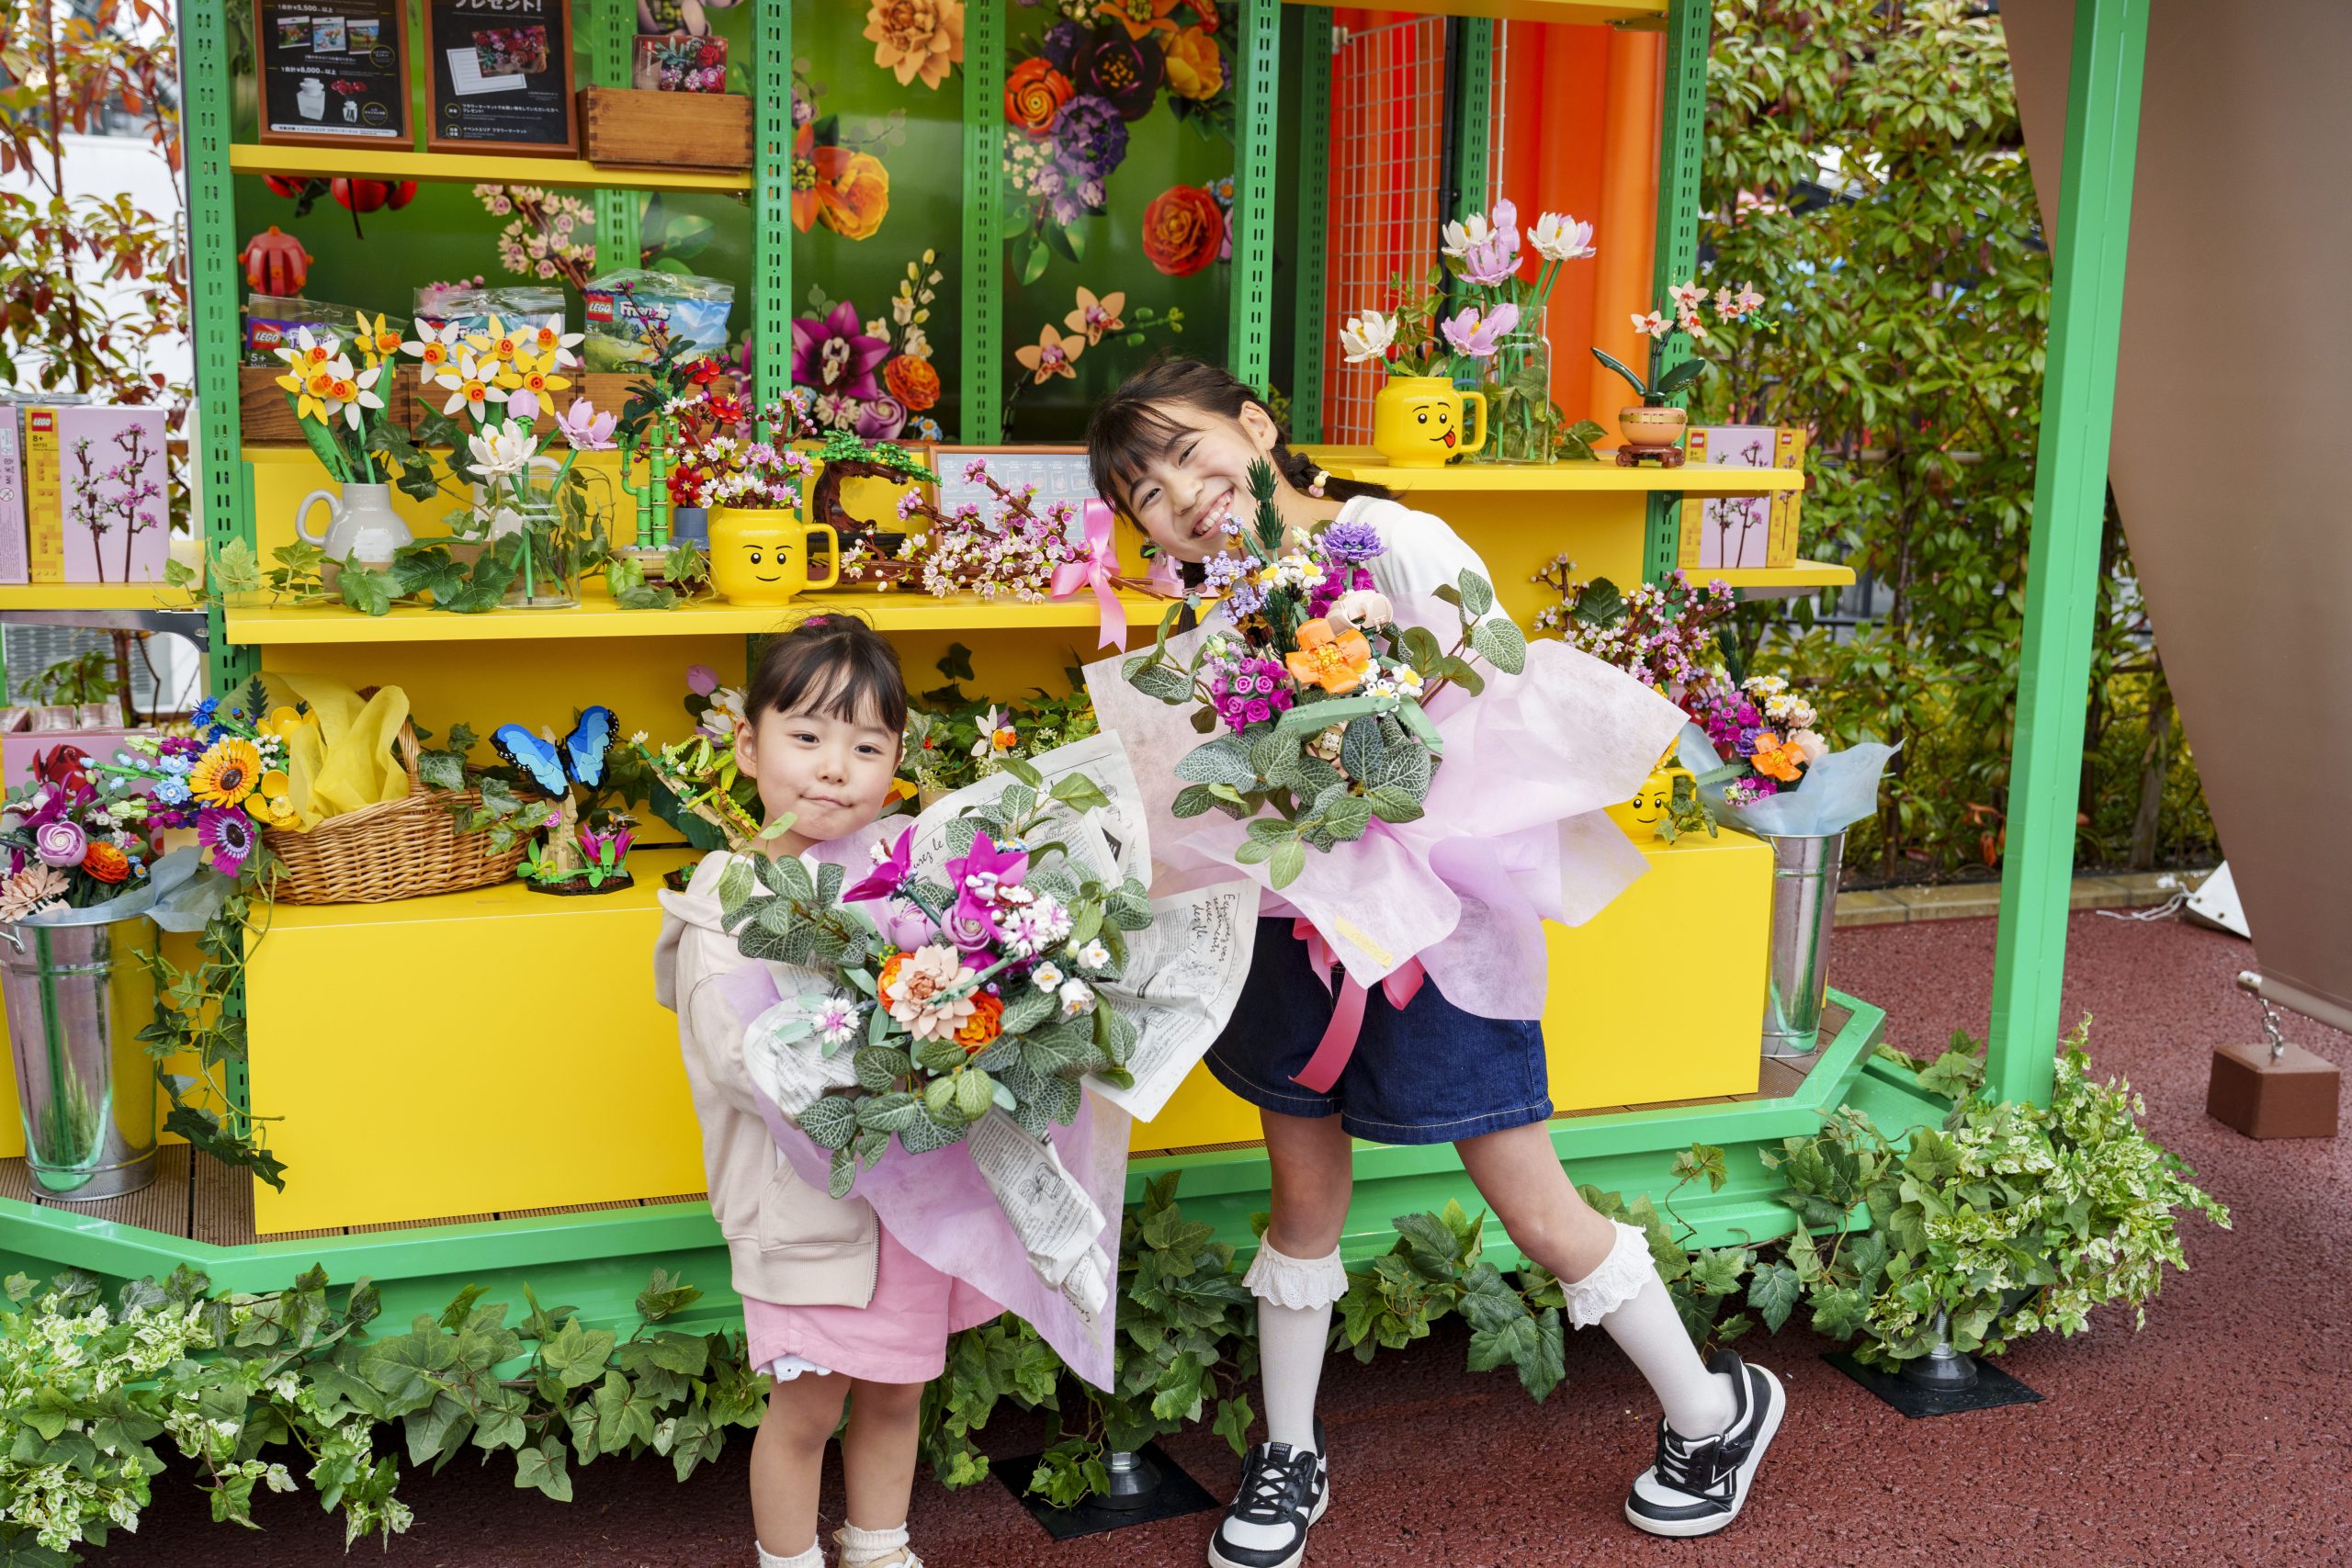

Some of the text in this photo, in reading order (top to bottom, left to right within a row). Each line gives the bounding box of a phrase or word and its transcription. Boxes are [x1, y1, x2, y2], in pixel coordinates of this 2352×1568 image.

[588, 302, 612, 313] LEGO
[586, 324, 601, 333] 5+
[254, 331, 279, 343] LEGO
[251, 353, 266, 362] 5+
[32, 434, 44, 443] 8+
[933, 837, 944, 851] le
[1192, 904, 1204, 921] des
